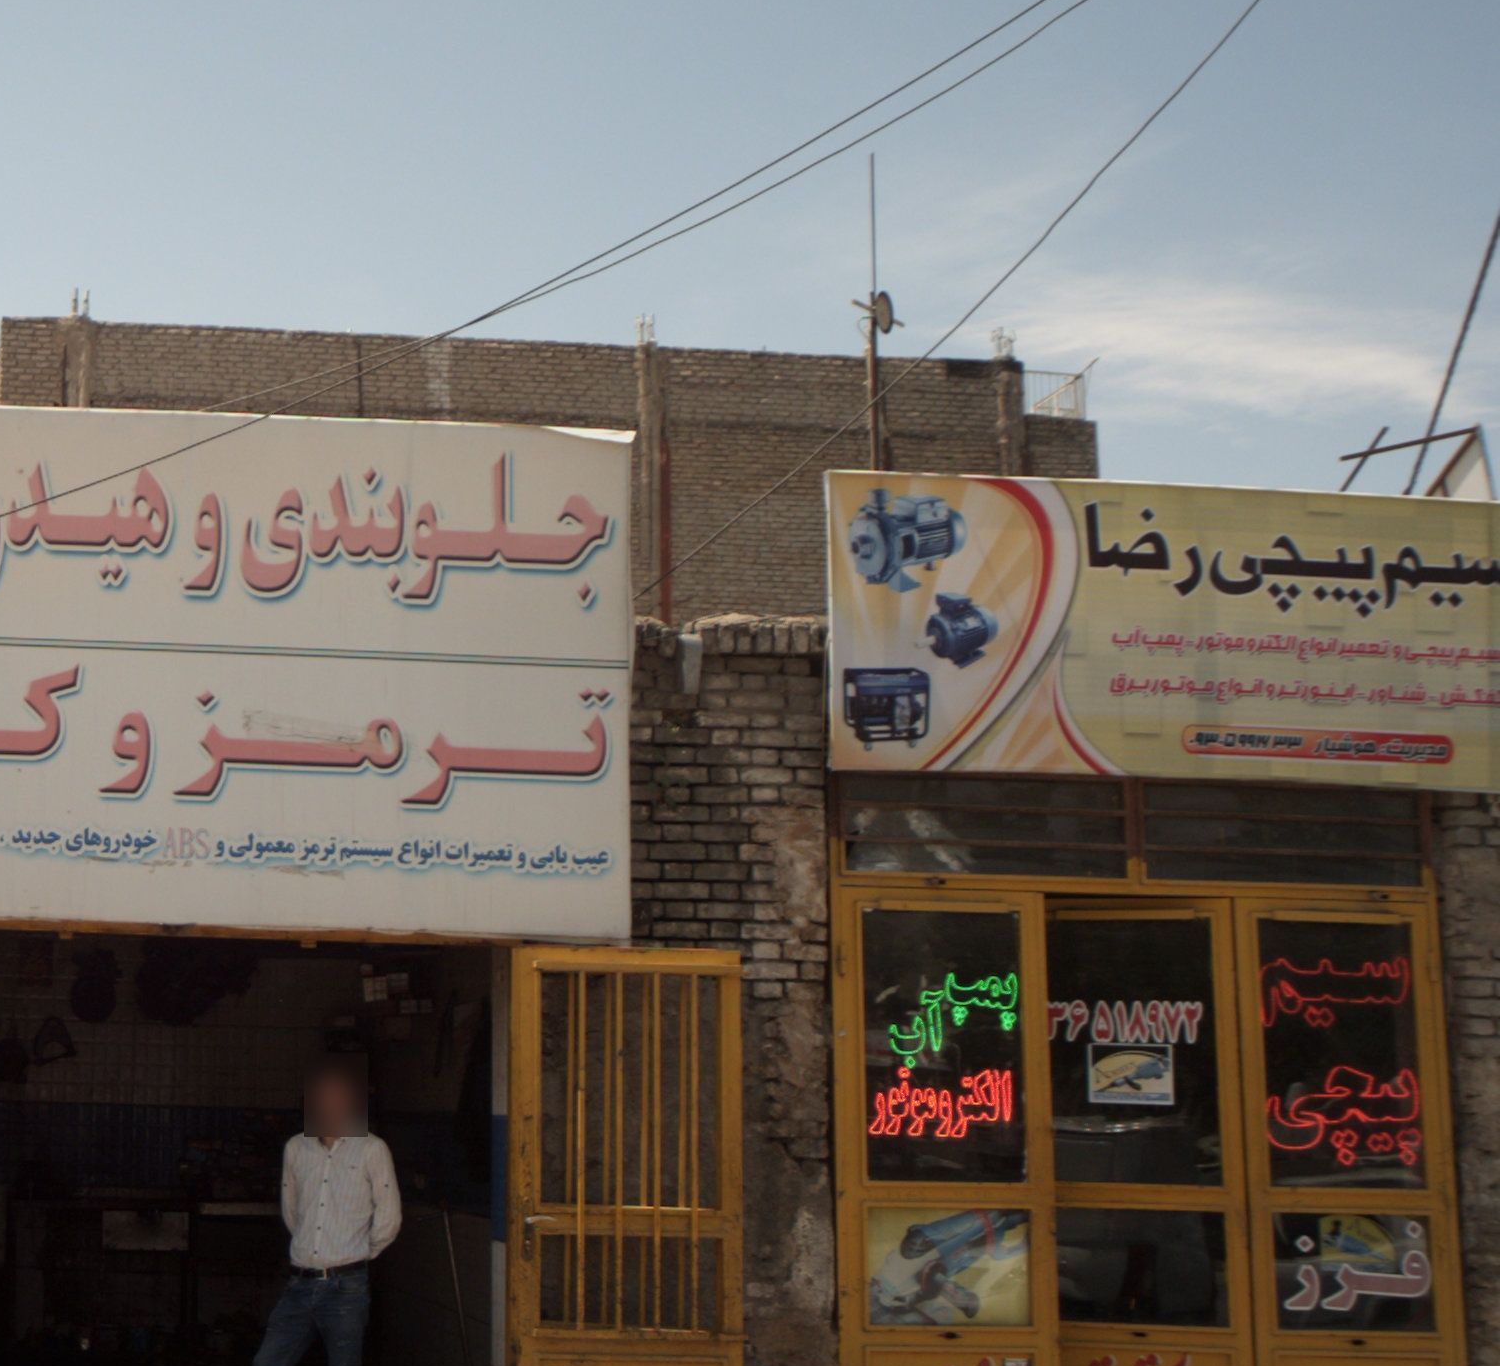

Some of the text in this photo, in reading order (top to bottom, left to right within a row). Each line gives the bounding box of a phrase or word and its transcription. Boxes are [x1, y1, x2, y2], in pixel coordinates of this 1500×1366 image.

[184, 481, 222, 593] و
[241, 455, 611, 602] جلوبندی
[1084, 500, 1204, 597] رضا
[1209, 534, 1382, 619] پیچی
[1298, 636, 1337, 662] انواع
[1338, 639, 1390, 662] تعمیر
[100, 711, 153, 794] و
[175, 688, 611, 807] ترمز
[12, 829, 62, 851] جدید
[65, 827, 157, 855] خودروهای
[162, 826, 212, 860] ABS
[214, 840, 226, 857] و
[229, 832, 295, 859] معمولی
[300, 837, 336, 861] ترمز
[340, 839, 394, 862] سیستم
[398, 839, 441, 865] انواع
[445, 841, 513, 867] تعمیرات
[516, 851, 527, 870] و
[530, 843, 568, 871] یابی
[572, 849, 609, 870] عیب
[1260, 957, 1411, 1027] سیم
[889, 972, 1019, 1069] پمپ آب
[869, 1066, 1013, 1139] الکتروموتور
[1267, 1065, 1422, 1166] پیچی
[1283, 1220, 1432, 1312] فرز
